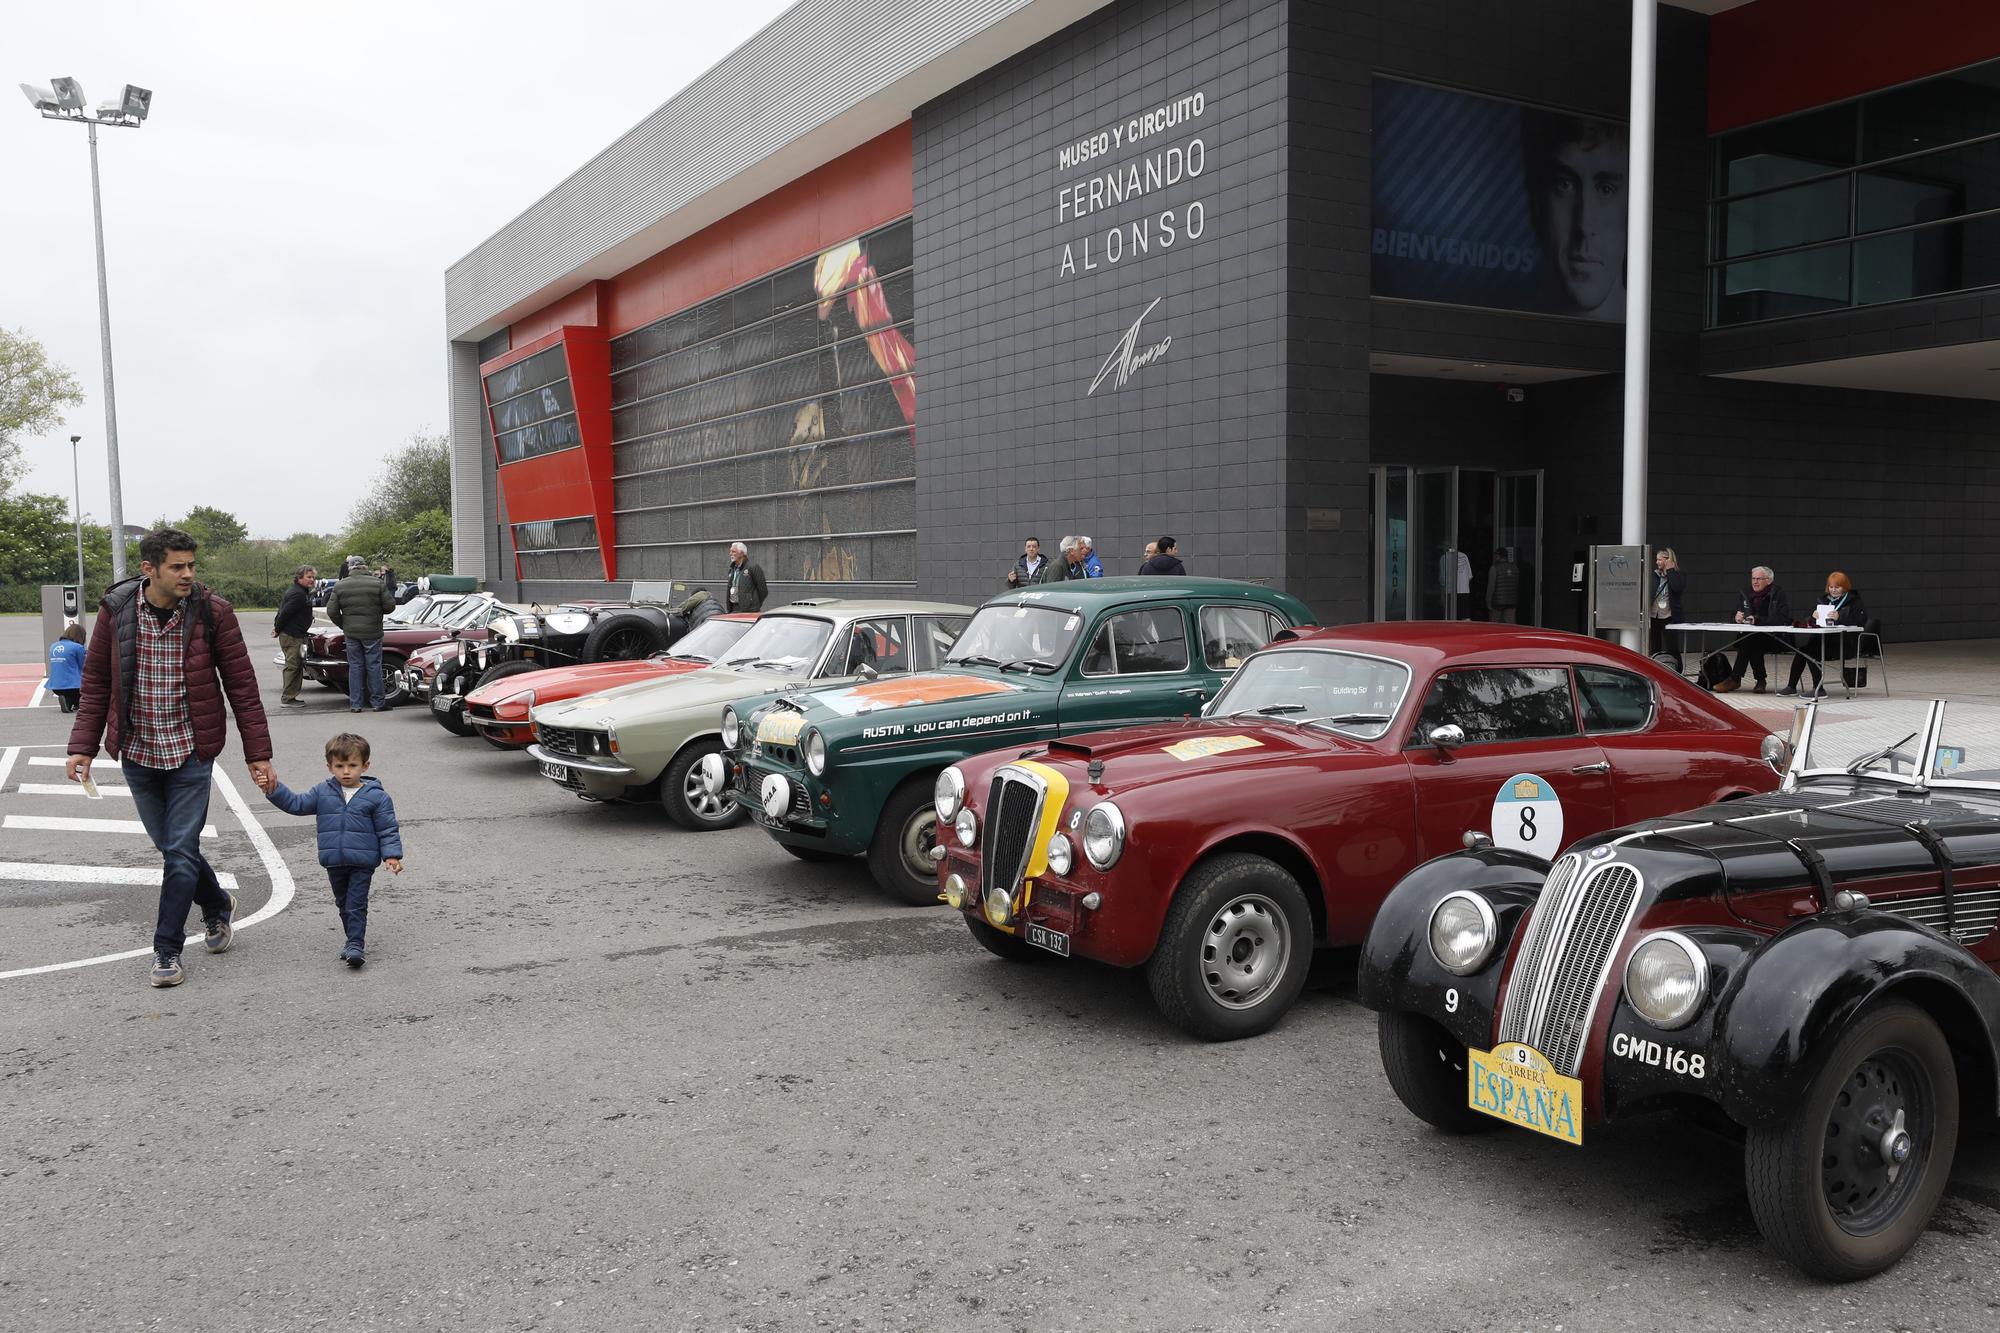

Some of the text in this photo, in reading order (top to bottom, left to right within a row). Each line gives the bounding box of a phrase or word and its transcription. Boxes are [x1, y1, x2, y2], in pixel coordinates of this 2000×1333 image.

[1059, 91, 1205, 171] MUSEO Y CIRCUITO
[1059, 138, 1205, 223] FERNANDO
[1060, 201, 1205, 278] ALONSO
[1372, 227, 1535, 273] BIENVENIDOS
[863, 724, 905, 739] AUSTIN
[913, 723, 936, 734] you
[938, 719, 961, 730] can
[962, 712, 1005, 728] depend
[1007, 712, 1021, 722] on
[1022, 709, 1031, 720] it
[763, 785, 777, 806] PIAA
[1070, 811, 1082, 829] 8
[1519, 806, 1537, 842] 8
[1032, 928, 1063, 951] CSK 132
[1444, 988, 1459, 1013] 9
[1518, 1049, 1527, 1063] 9
[1612, 1033, 1706, 1079] GMD 168
[1500, 1062, 1546, 1085] CARRERA
